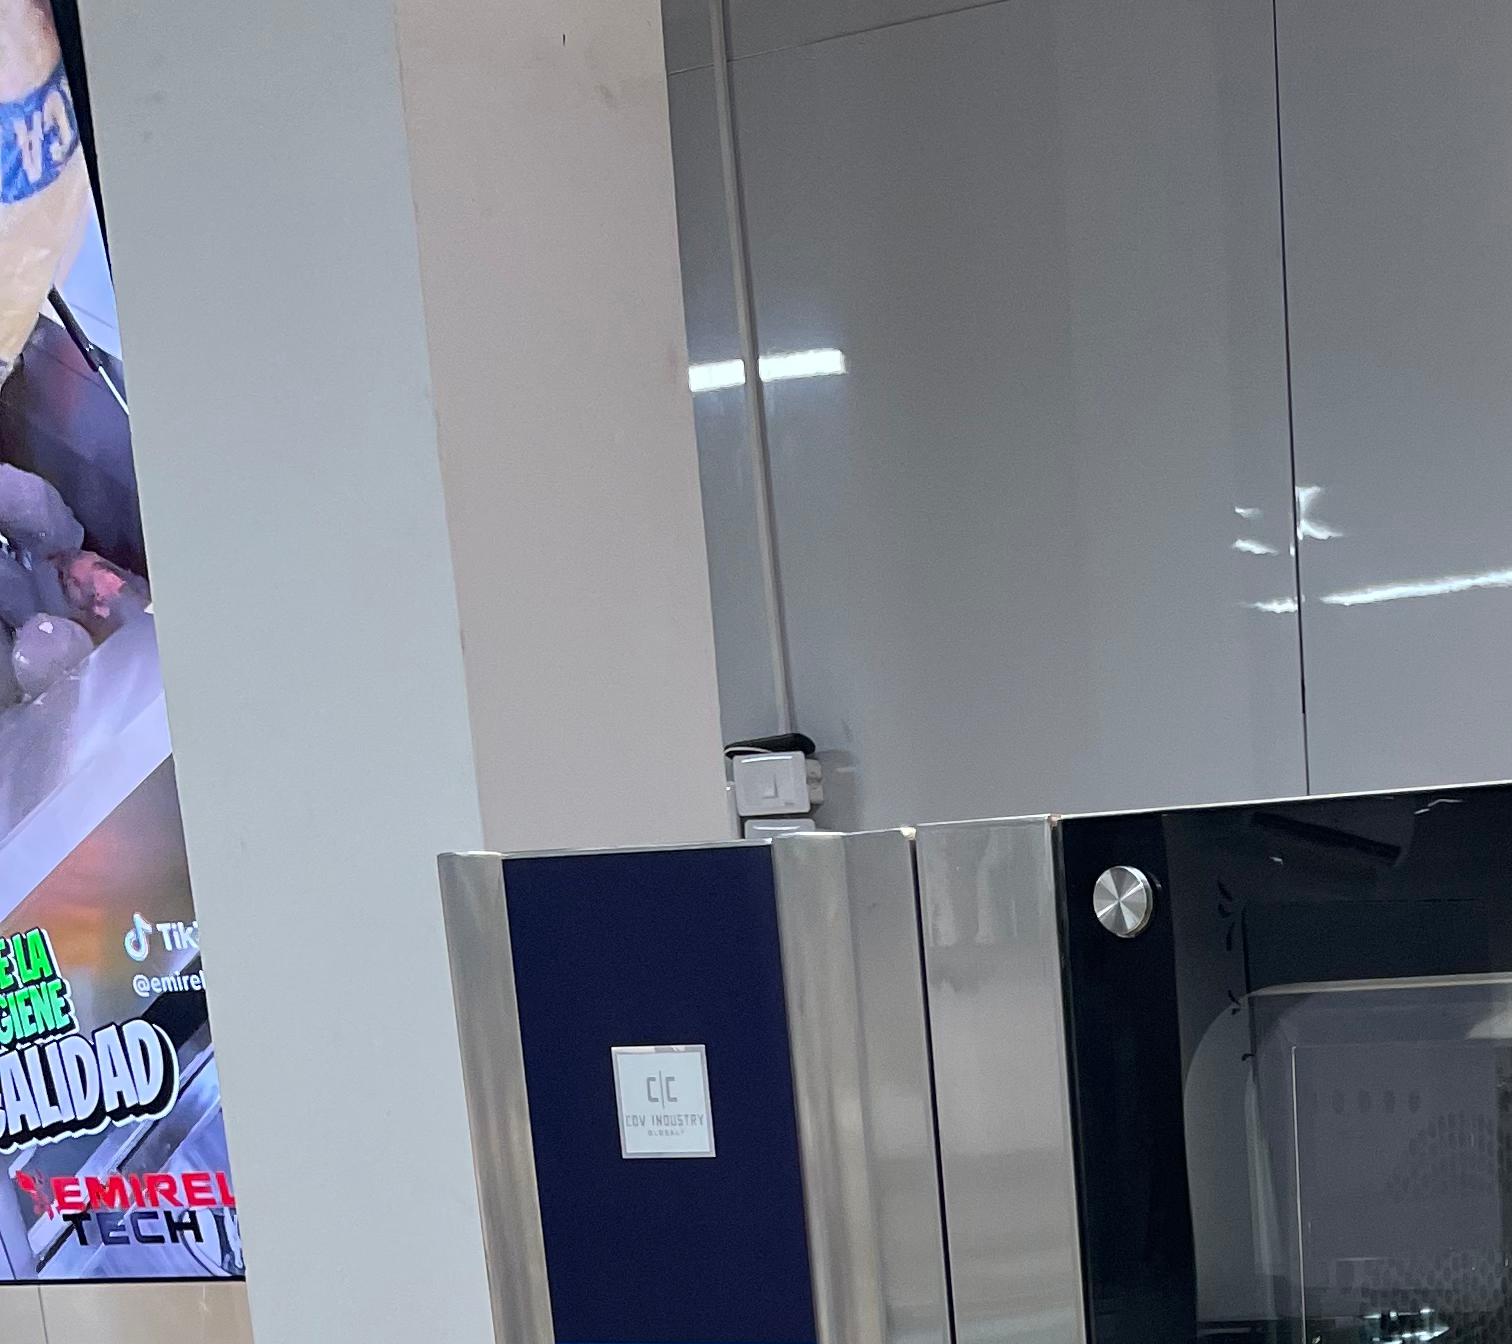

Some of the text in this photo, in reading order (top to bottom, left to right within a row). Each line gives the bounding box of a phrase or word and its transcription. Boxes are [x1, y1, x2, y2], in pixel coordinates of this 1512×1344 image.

[12, 928, 53, 984] LA
[156, 921, 200, 951] Tik
[0, 1020, 165, 1142] ALIDAD
[62, 1210, 204, 1246] TECH
